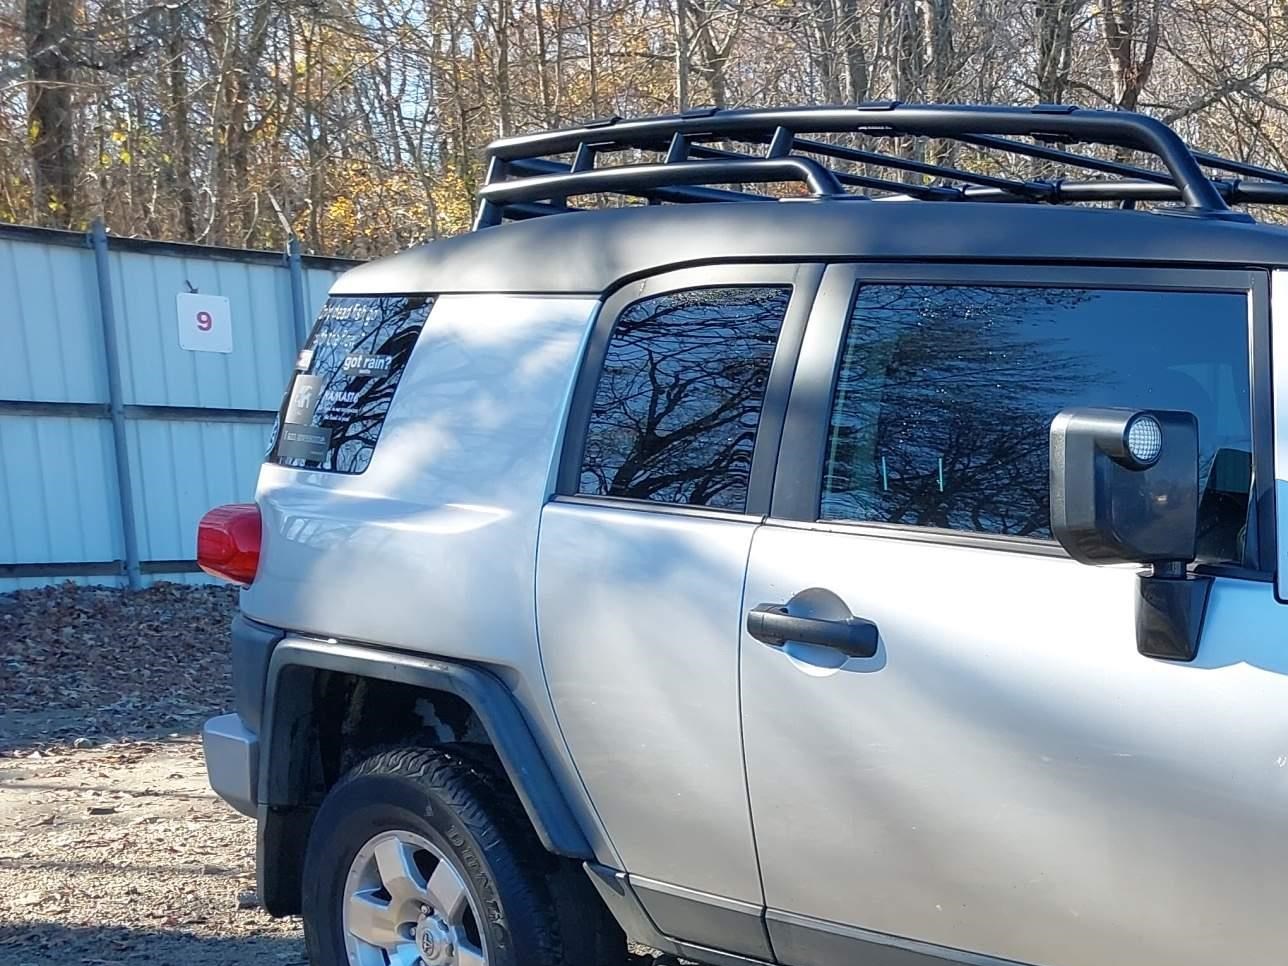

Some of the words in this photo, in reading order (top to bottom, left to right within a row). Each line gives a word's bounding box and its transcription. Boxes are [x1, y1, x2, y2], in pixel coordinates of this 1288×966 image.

[196, 311, 213, 332] 9
[343, 355, 363, 370] got
[362, 355, 392, 370] rain?
